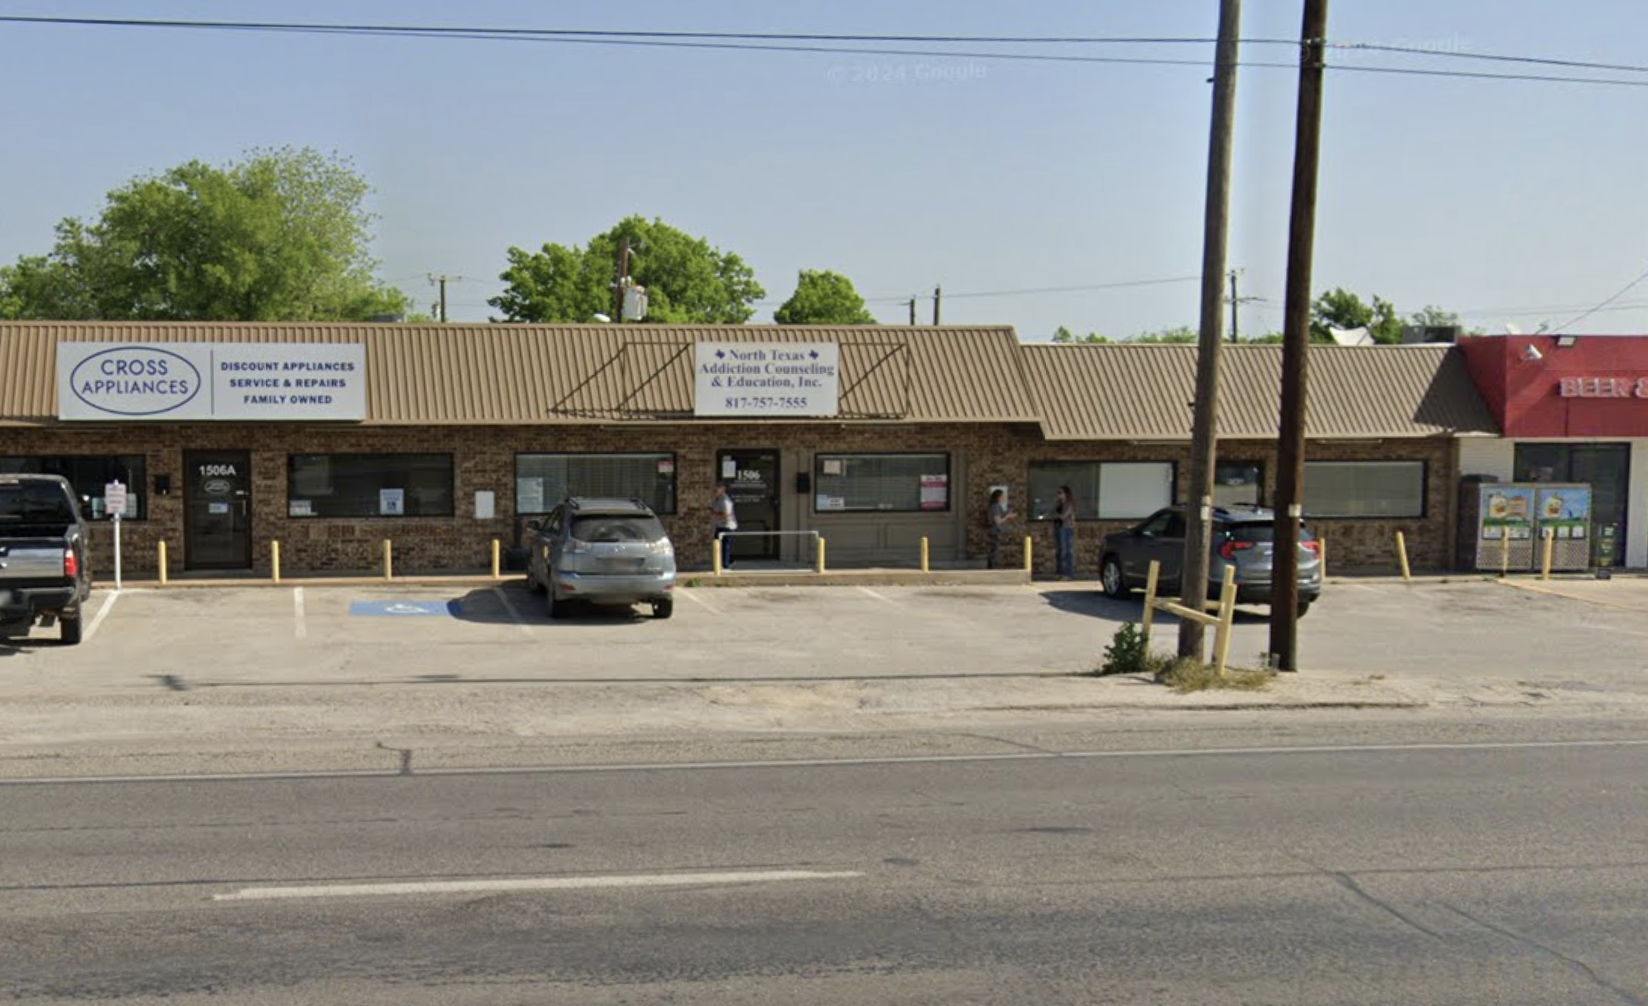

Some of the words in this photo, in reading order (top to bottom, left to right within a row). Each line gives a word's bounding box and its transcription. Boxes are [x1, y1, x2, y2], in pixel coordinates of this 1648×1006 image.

[730, 350, 766, 360] North
[771, 350, 805, 360] Texas
[101, 359, 168, 375] CROSS
[220, 362, 279, 371] DISCOUNT
[282, 362, 355, 371] APPLIANCES
[700, 363, 761, 374] Addiction
[764, 363, 834, 376] Counseling
[81, 380, 189, 394] APPLIANCES
[229, 379, 279, 388] SERVICE
[282, 379, 292, 388] &
[295, 379, 346, 388] REPAIRS
[711, 377, 722, 387] &
[727, 376, 795, 388] Education,
[798, 376, 822, 387] Inc.
[1560, 378, 1630, 397] BEER
[243, 395, 287, 404] FAMILY
[290, 395, 332, 404] OWNED
[725, 398, 807, 408] 817-757-7555
[199, 464, 237, 476] 1506A
[737, 470, 761, 480] 1506
